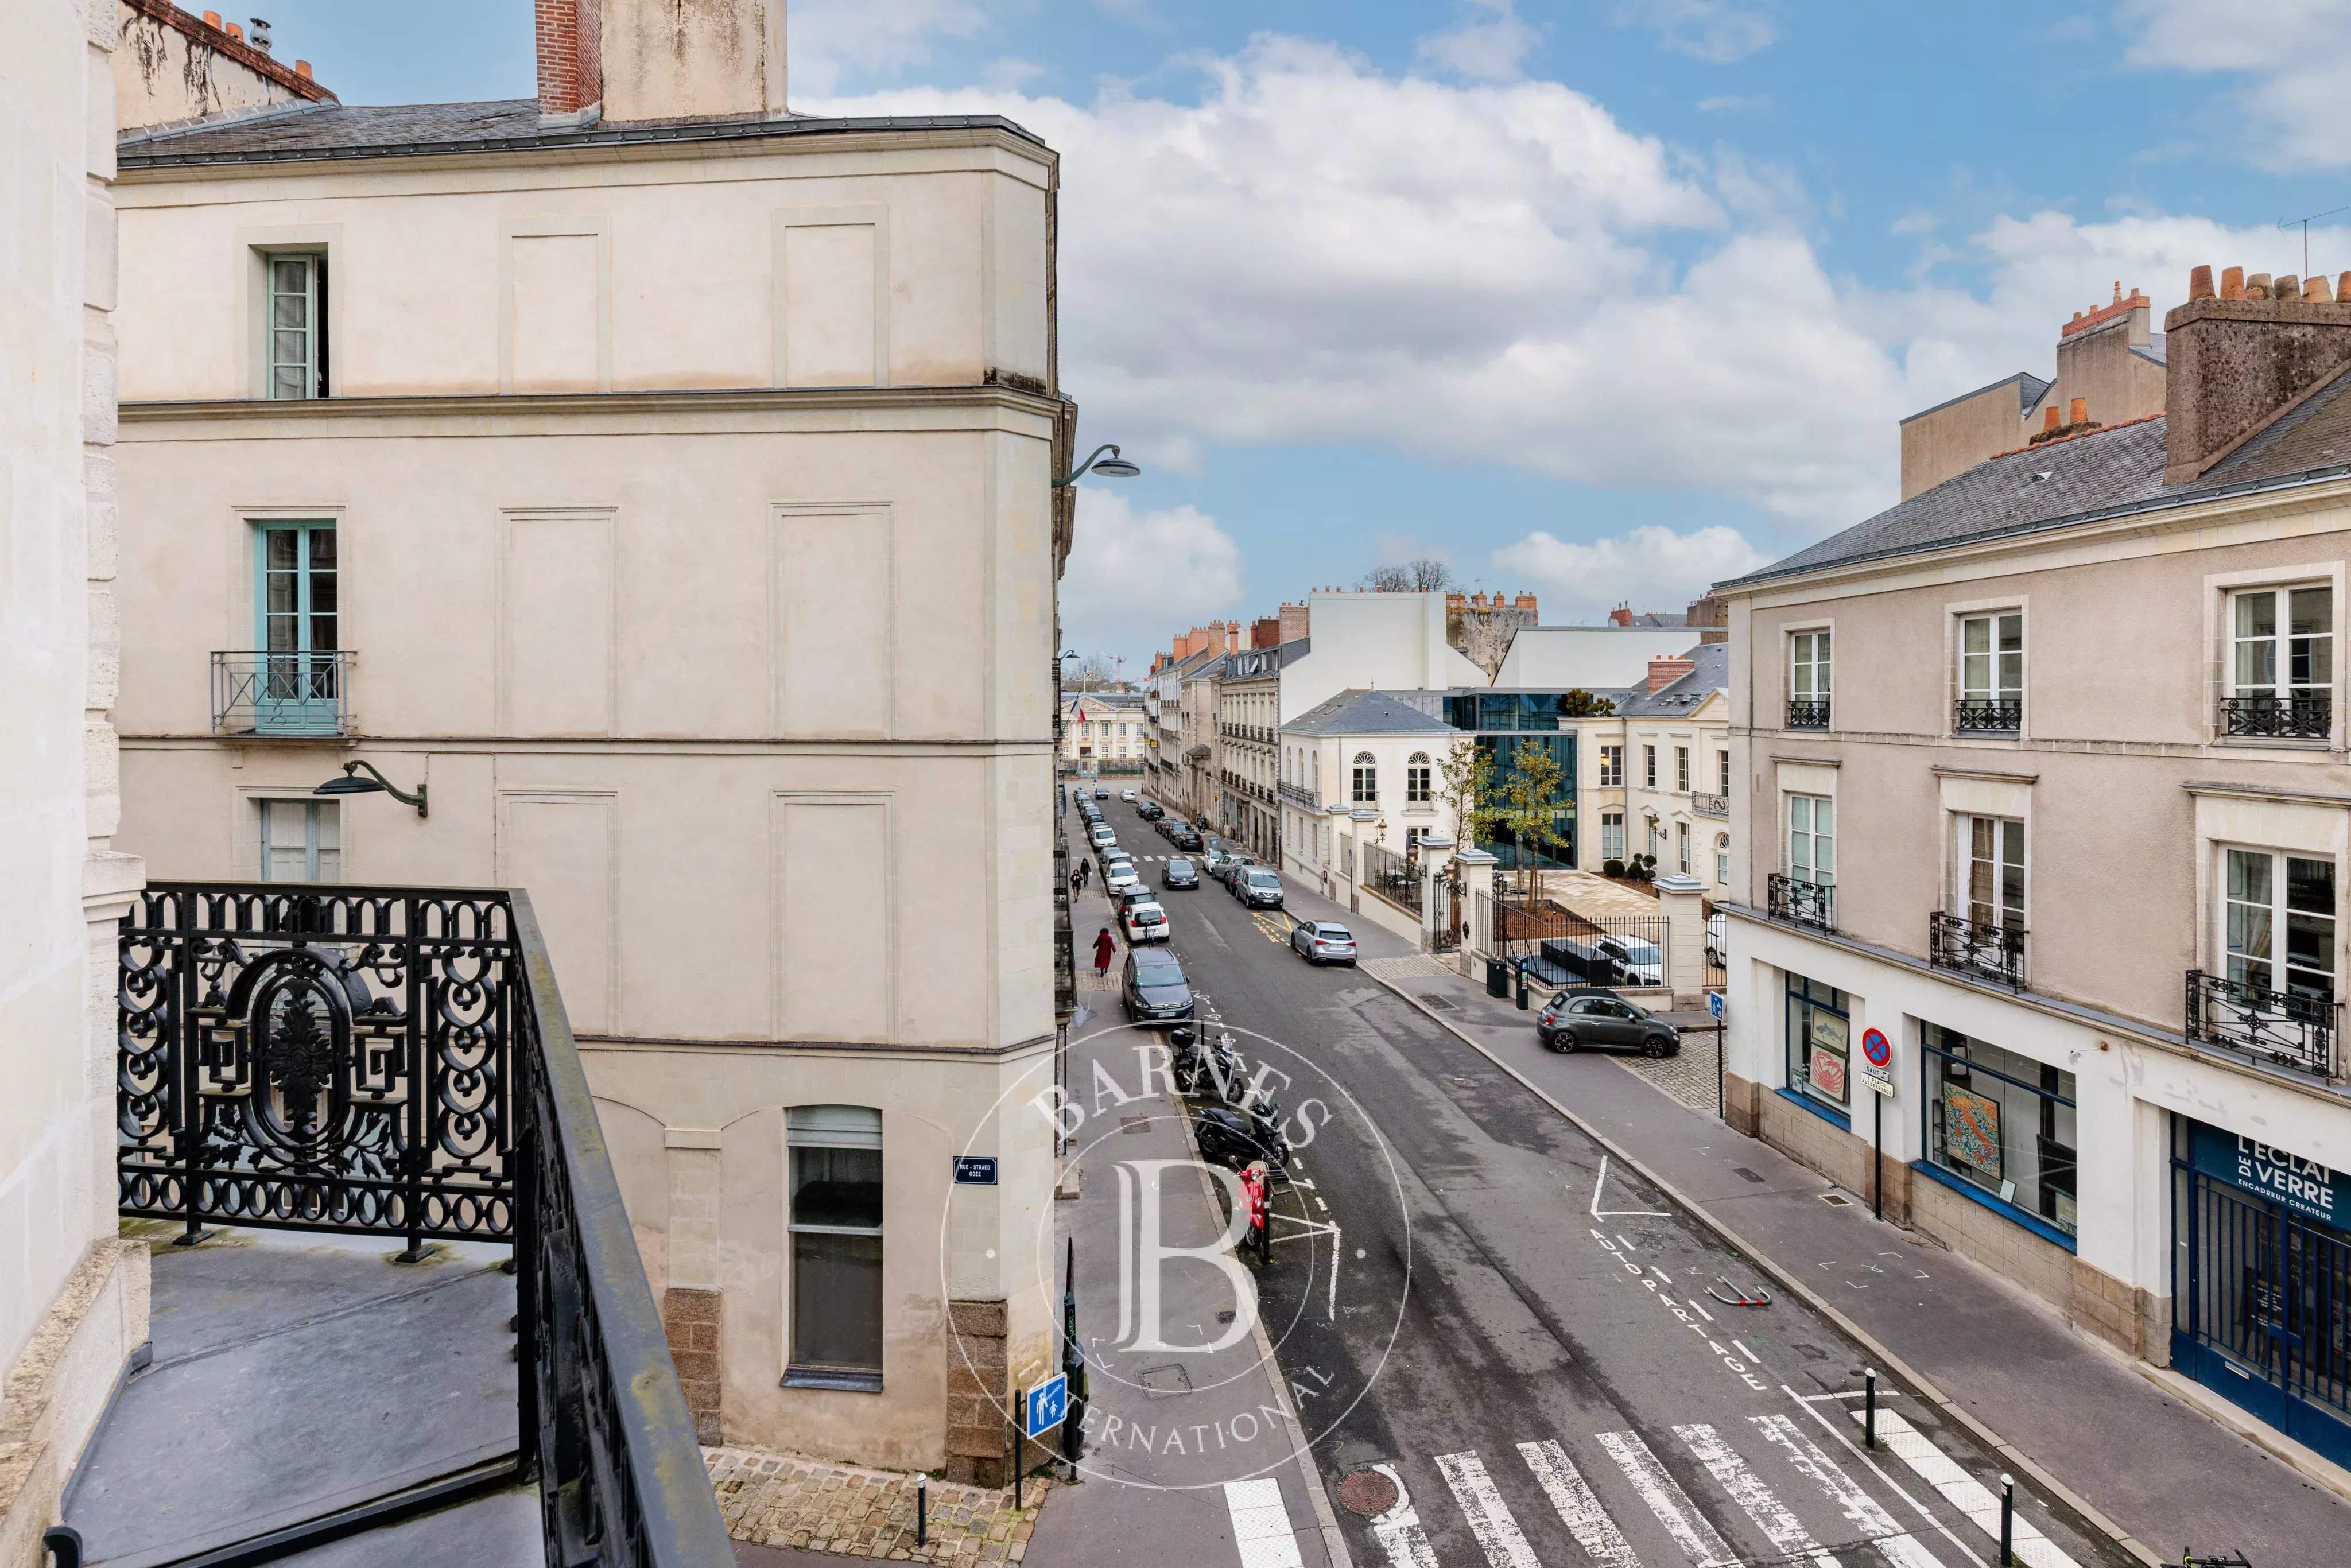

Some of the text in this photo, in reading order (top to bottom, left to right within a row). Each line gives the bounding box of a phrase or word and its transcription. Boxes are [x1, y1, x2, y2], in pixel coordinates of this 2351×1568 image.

[1866, 1066, 1879, 1074] SAUF
[1862, 1079, 1892, 1096] AUTOPARTAGE
[1872, 1078, 1886, 1088] PLACE
[2239, 1135, 2332, 1185] LECLAT
[2239, 1156, 2251, 1177] DE
[2255, 1161, 2333, 1209] VERRE
[2238, 1179, 2331, 1221] ENCADREUR CREATEUR
